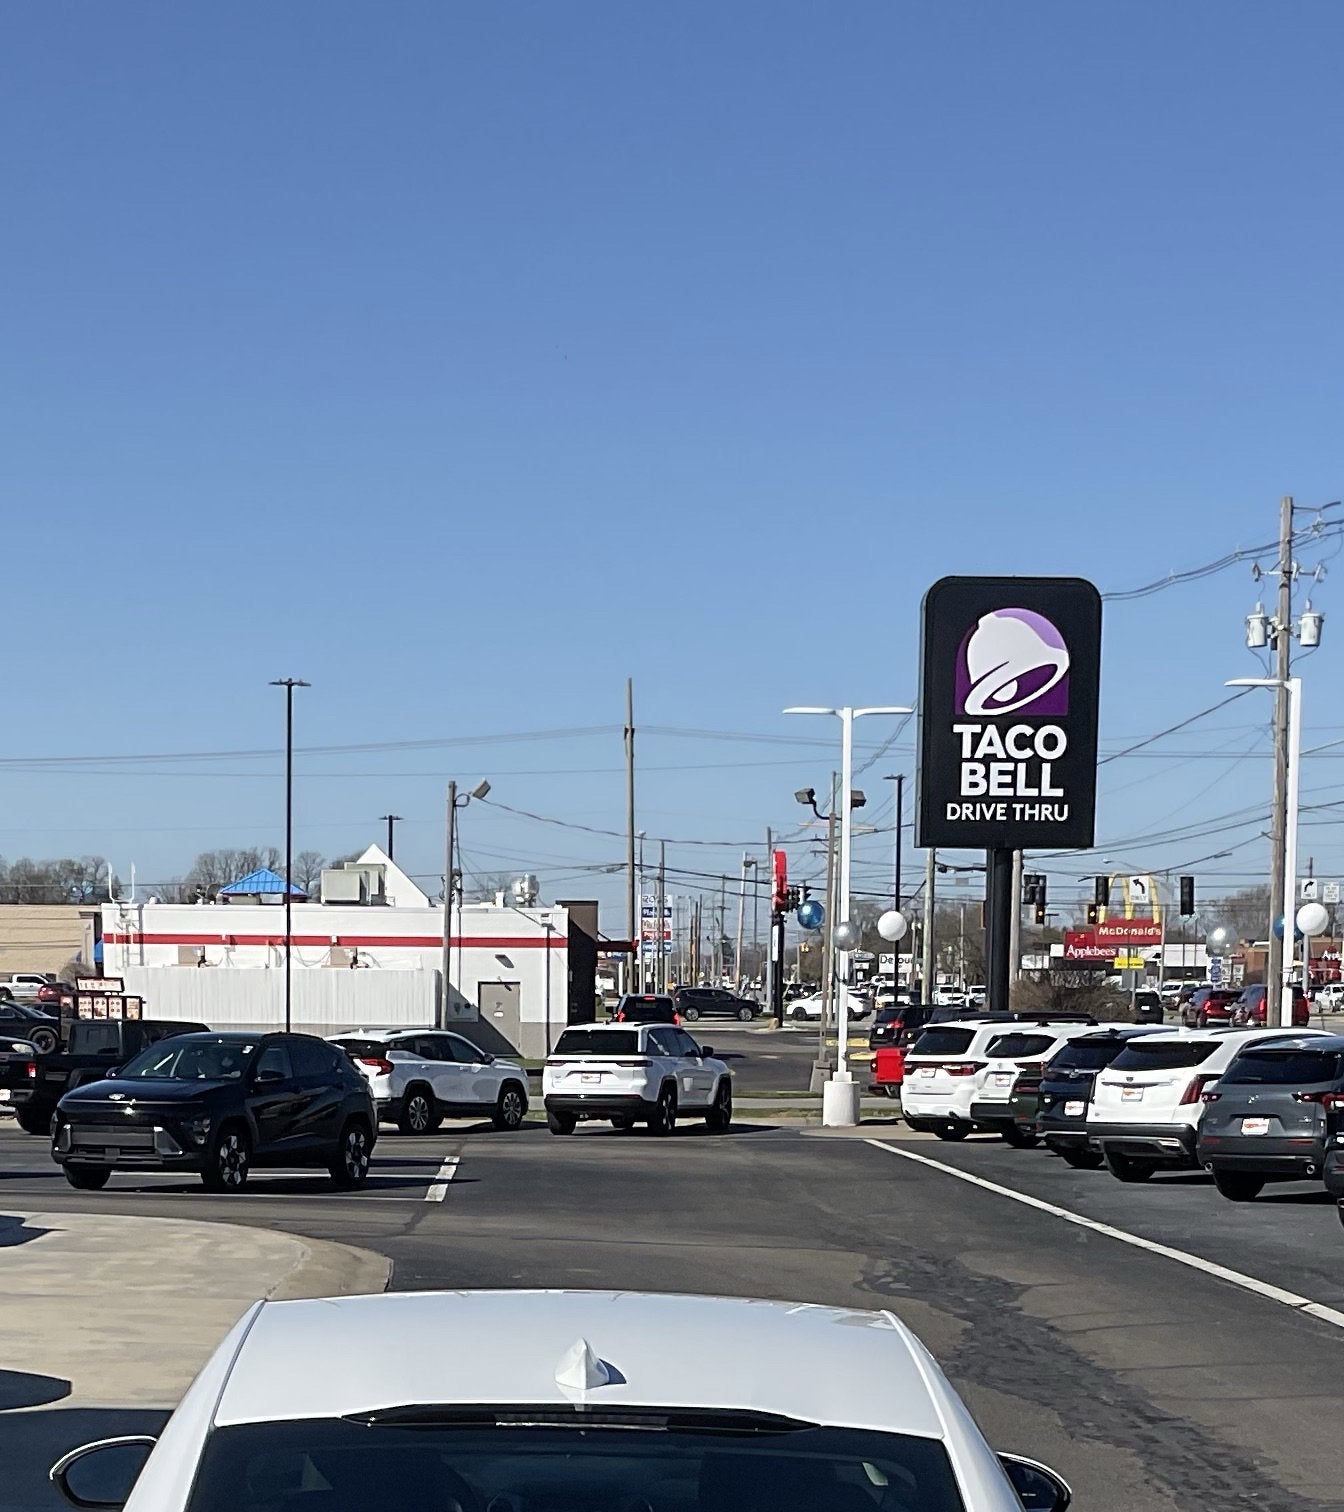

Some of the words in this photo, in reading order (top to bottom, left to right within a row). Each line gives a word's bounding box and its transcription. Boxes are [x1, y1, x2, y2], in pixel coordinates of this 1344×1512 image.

[952, 724, 1068, 760] TACO
[960, 761, 1064, 797] BELL
[946, 803, 1008, 821] DRIVE
[1012, 803, 1069, 821] THRU
